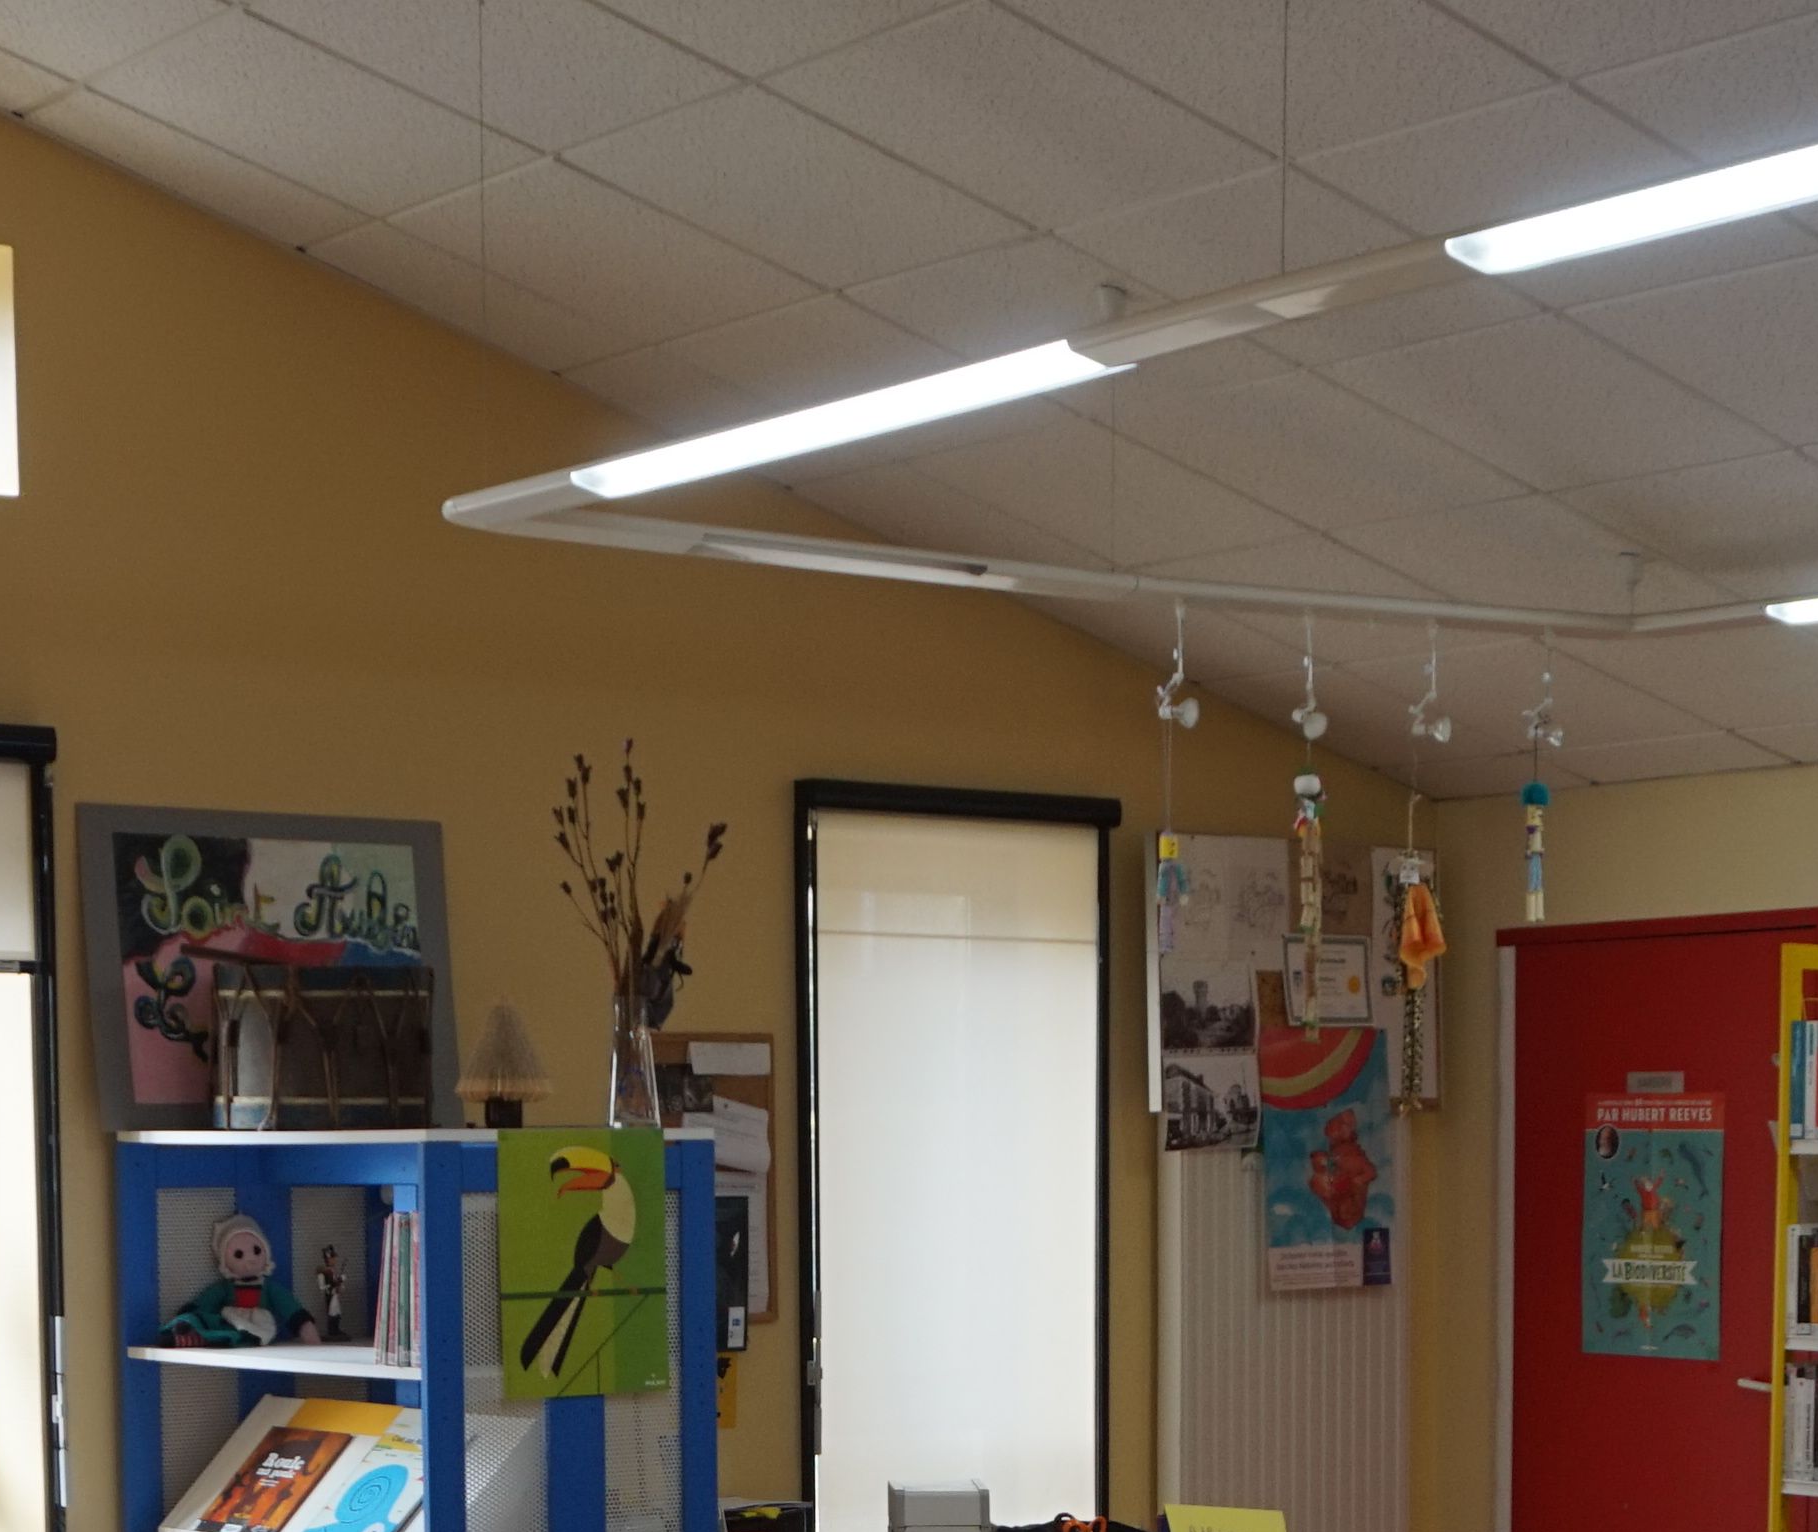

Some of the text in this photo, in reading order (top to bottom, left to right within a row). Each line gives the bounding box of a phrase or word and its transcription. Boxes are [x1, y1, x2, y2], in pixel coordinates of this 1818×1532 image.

[1596, 1106, 1713, 1122] PAR HUBERT REEVES
